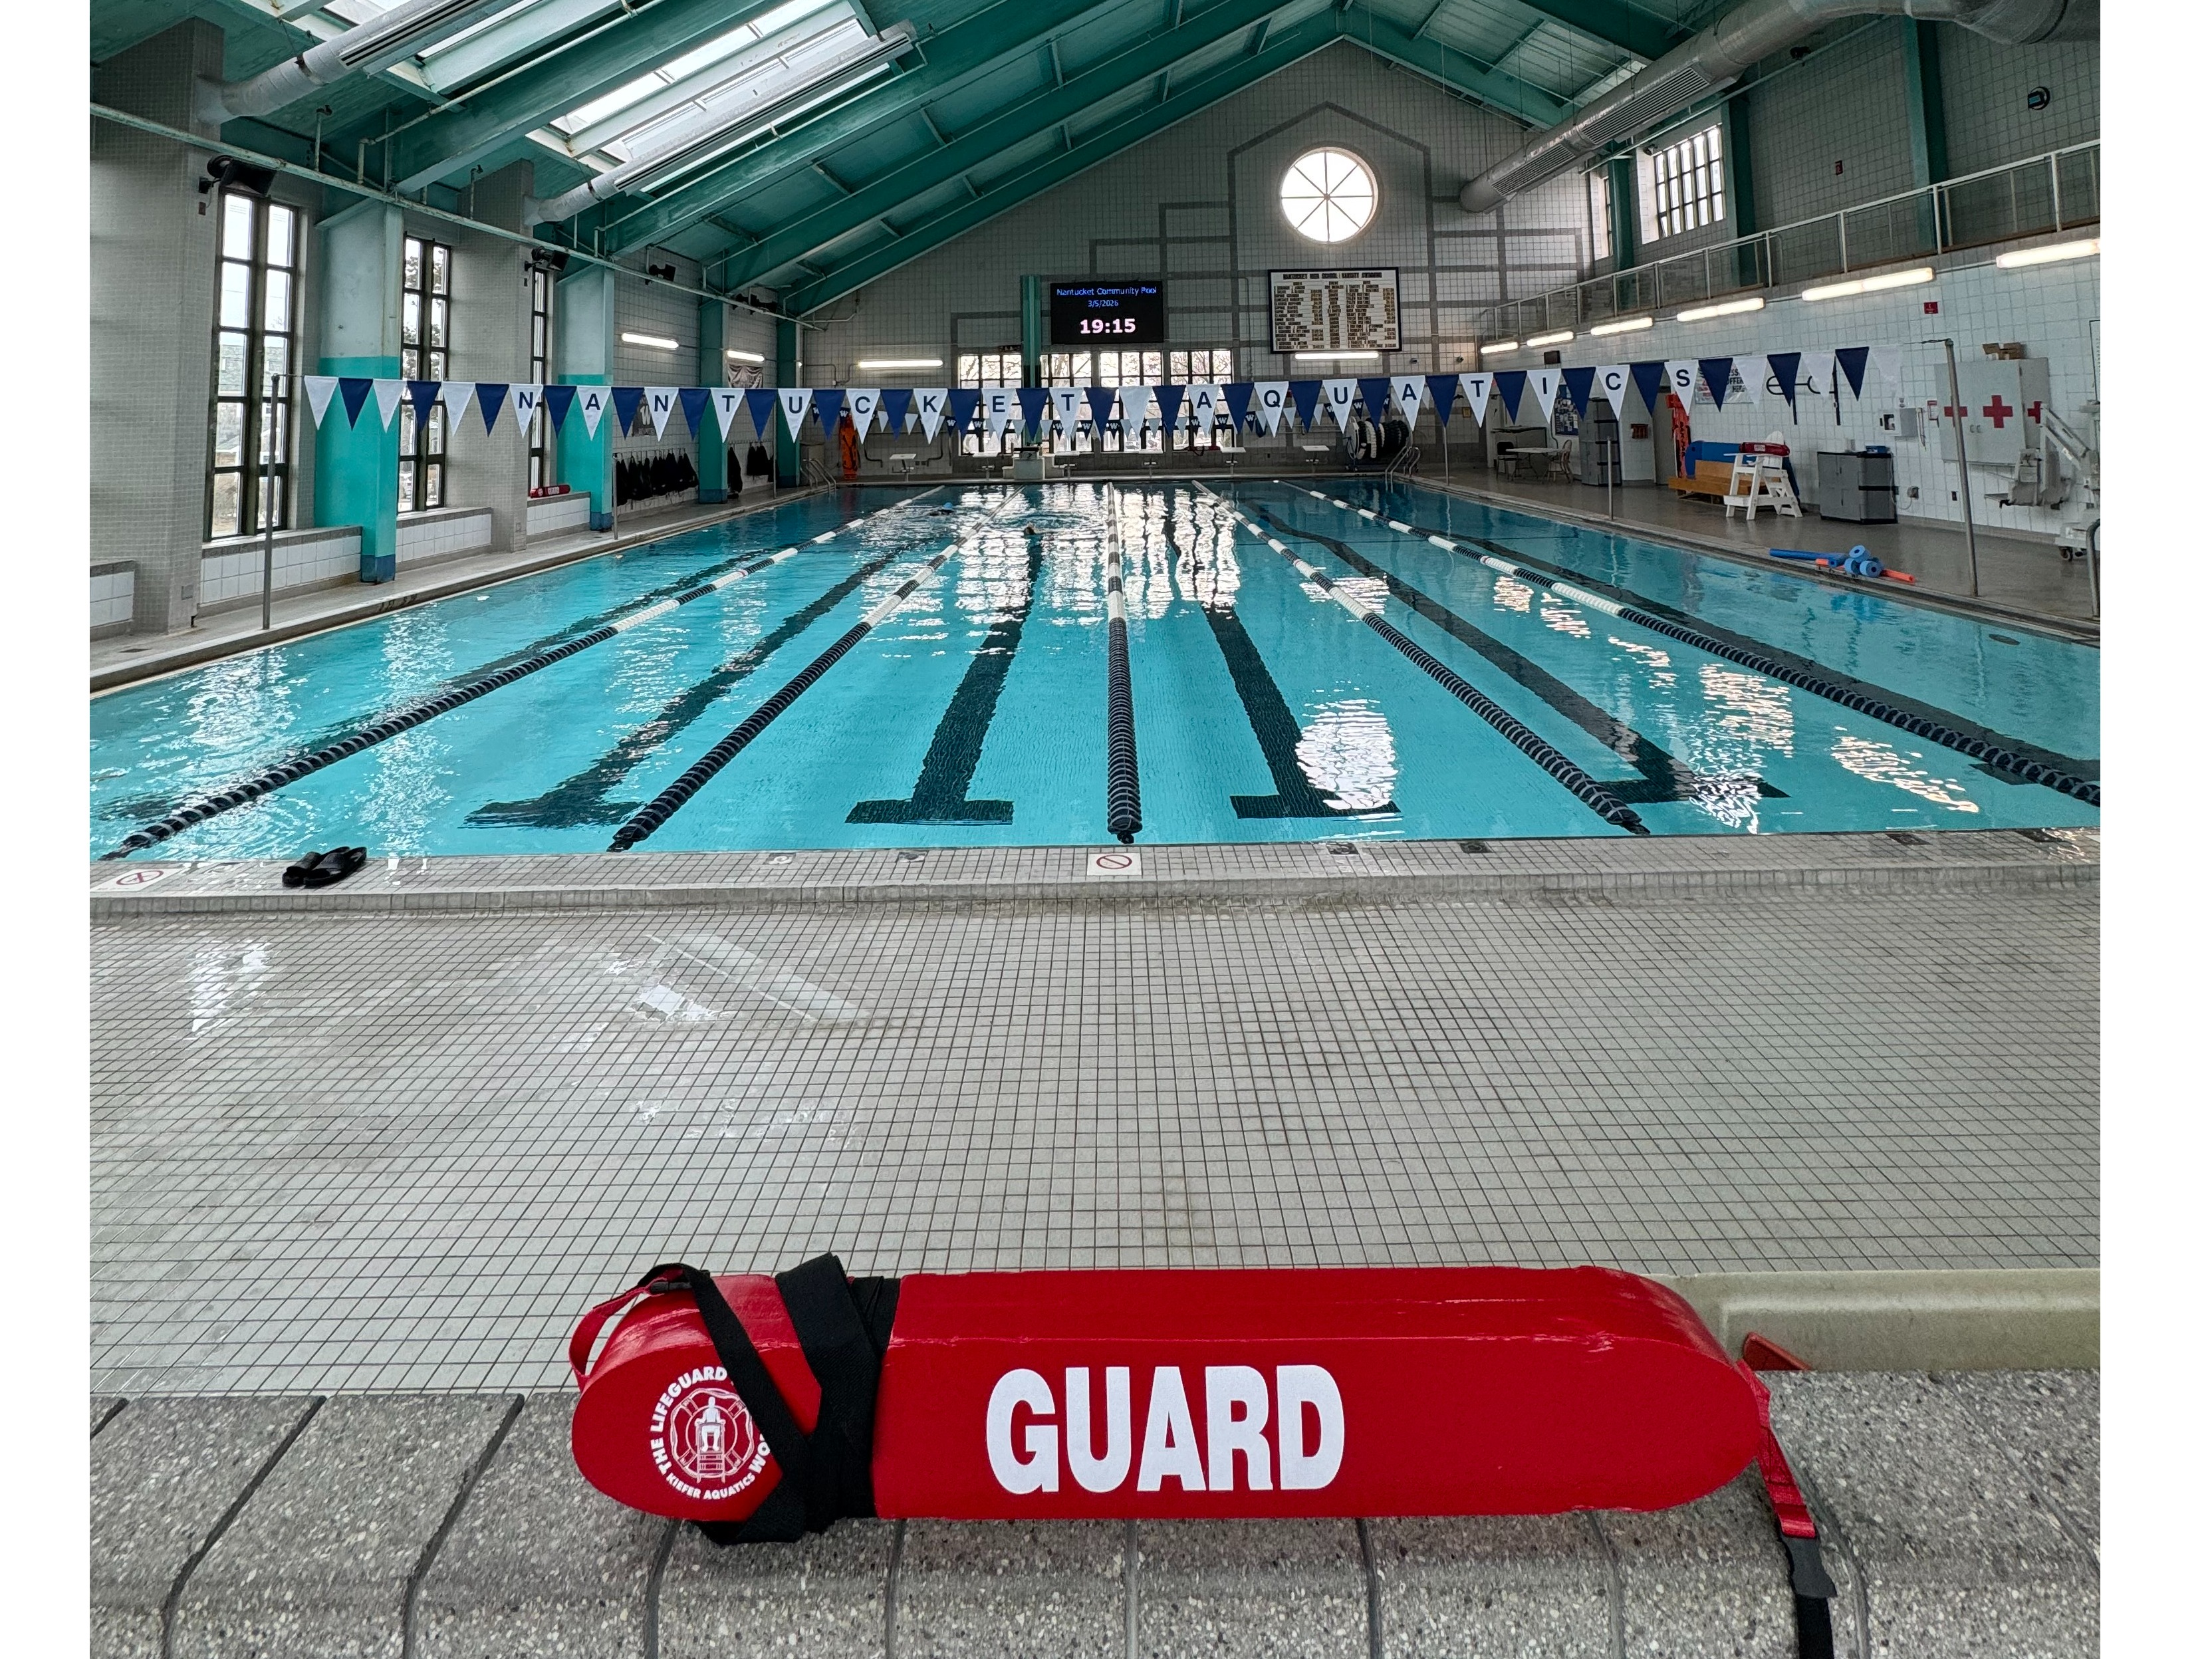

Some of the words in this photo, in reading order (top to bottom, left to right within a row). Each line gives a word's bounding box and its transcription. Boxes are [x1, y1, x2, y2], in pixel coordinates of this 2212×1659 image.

[1088, 299, 1119, 309] 3/5/2026
[1097, 287, 1140, 296] Community
[1080, 318, 1136, 334] 19:15
[650, 1366, 728, 1433] LIFEGUARD
[986, 1364, 1345, 1495] GUARD
[650, 1437, 672, 1475] THE
[666, 1472, 701, 1499] KIEFER
[703, 1471, 755, 1500] AQUATICS
